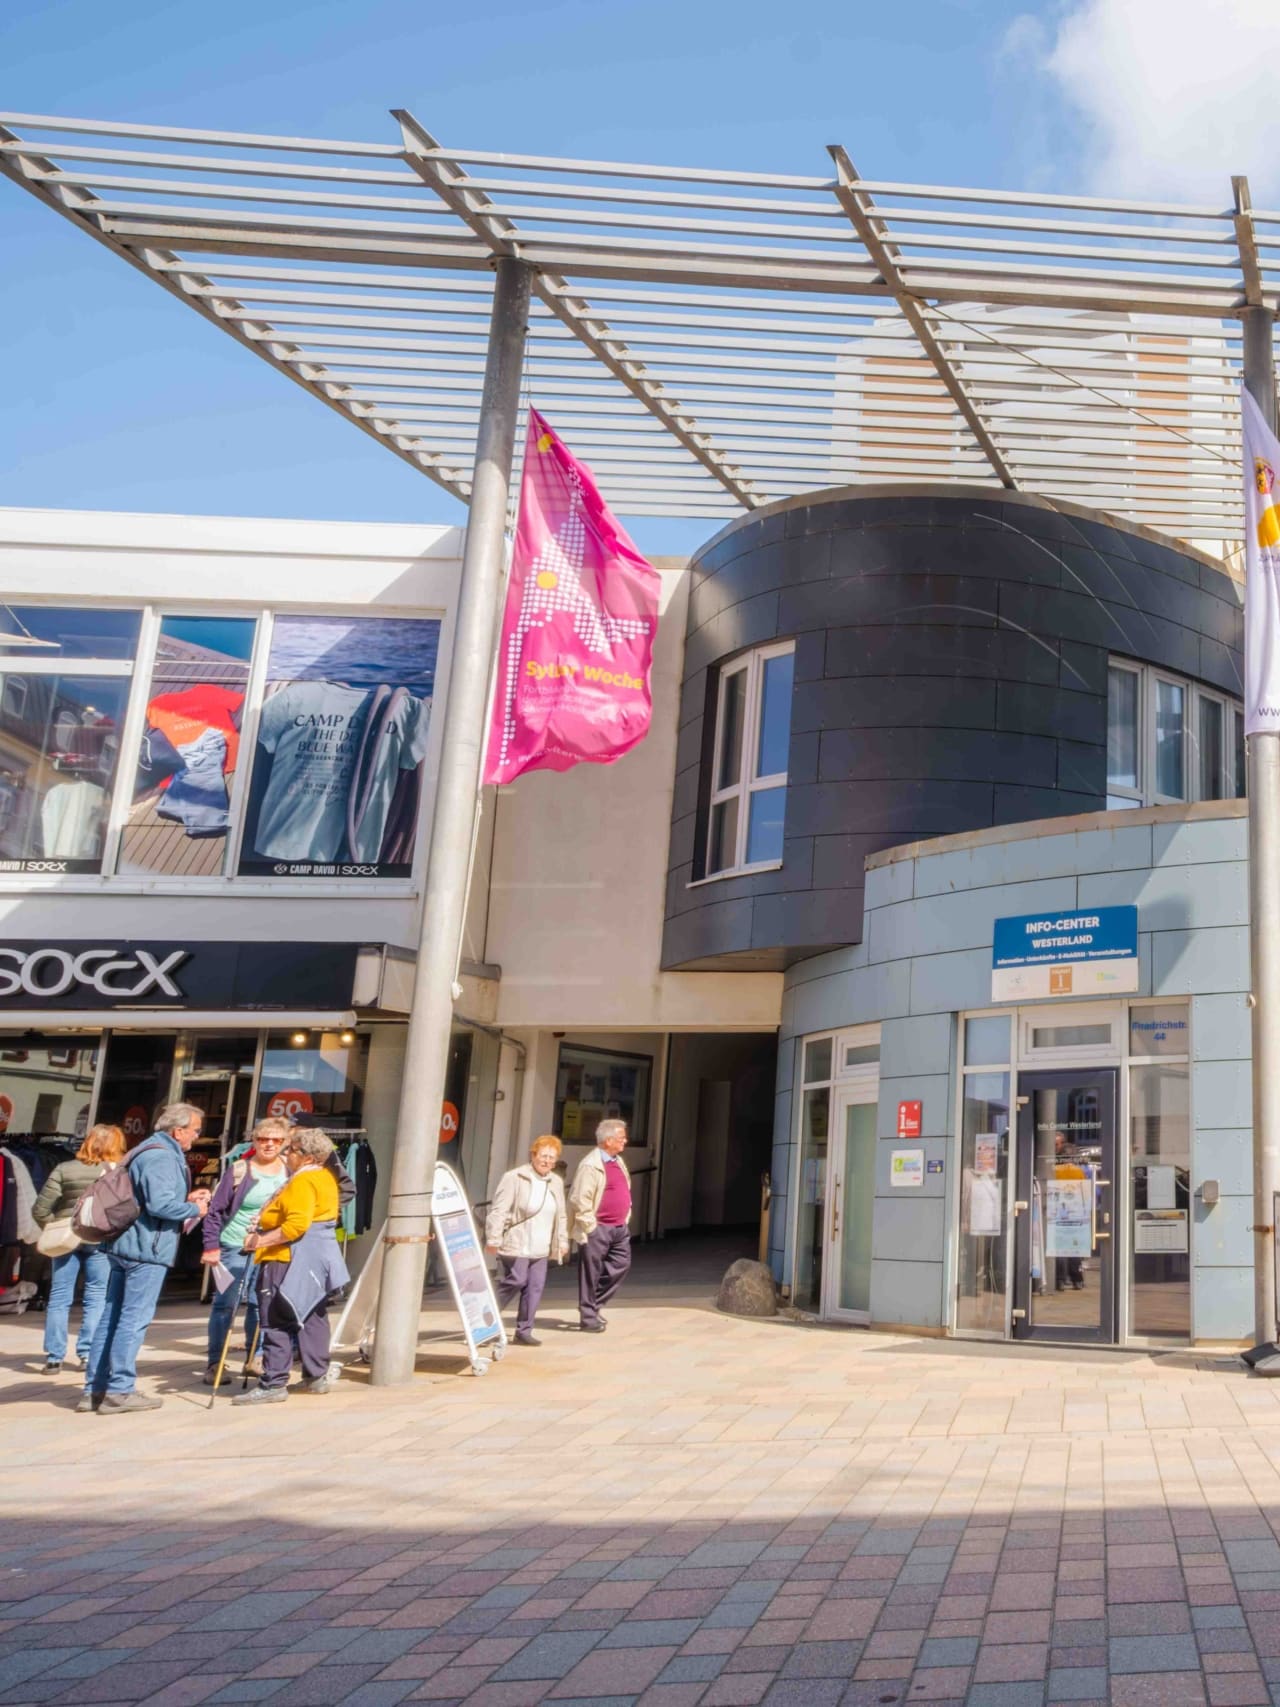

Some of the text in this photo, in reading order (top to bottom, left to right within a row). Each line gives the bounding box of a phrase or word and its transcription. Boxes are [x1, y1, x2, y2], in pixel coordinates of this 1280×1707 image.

[583, 664, 643, 690] Woche
[294, 713, 345, 727] CAMP
[289, 864, 312, 874] CAMP
[313, 864, 336, 875] DAVID
[1025, 916, 1100, 934] INFO-CENTER
[1032, 934, 1093, 949] WESTERLAND
[271, 1099, 307, 1119] 50
